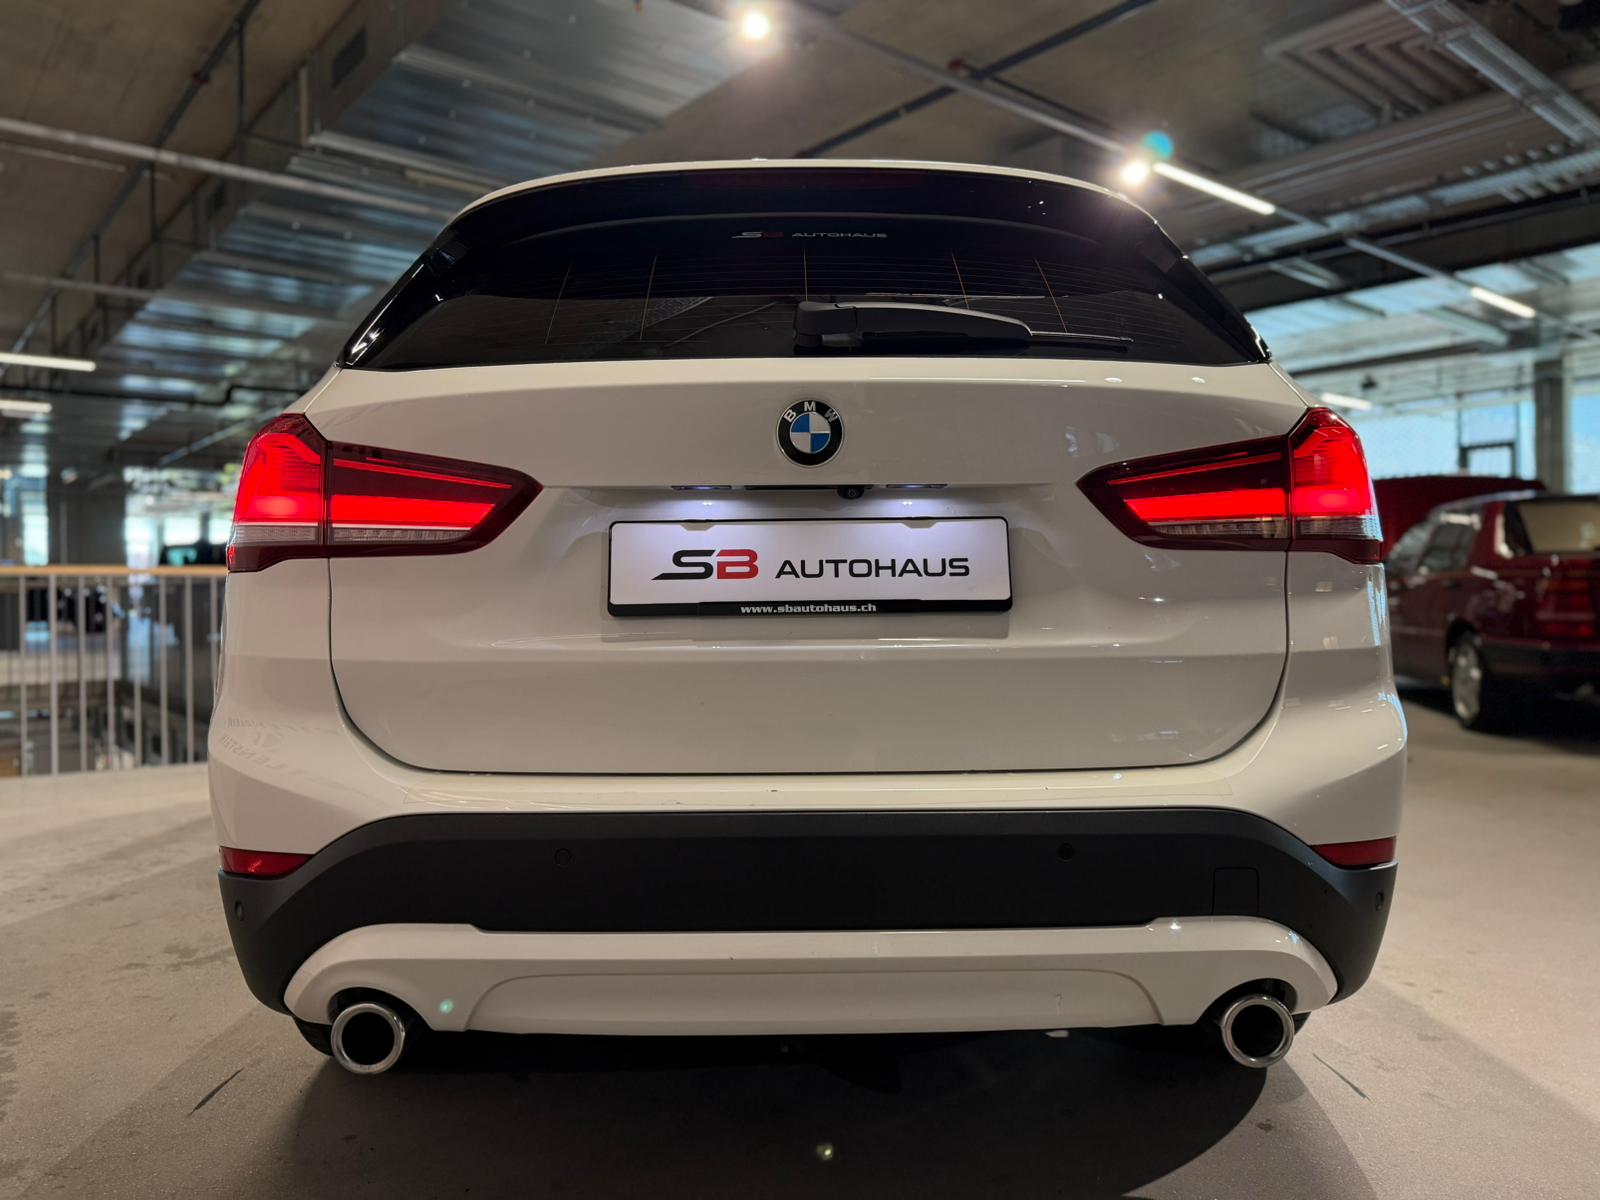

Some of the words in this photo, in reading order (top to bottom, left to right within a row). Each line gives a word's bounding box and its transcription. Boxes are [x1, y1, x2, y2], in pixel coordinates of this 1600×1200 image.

[783, 401, 839, 423] BMW
[651, 549, 759, 581] SB
[775, 557, 970, 579] AUTOHAUS
[740, 603, 877, 614] www.sbautohaus.ch
